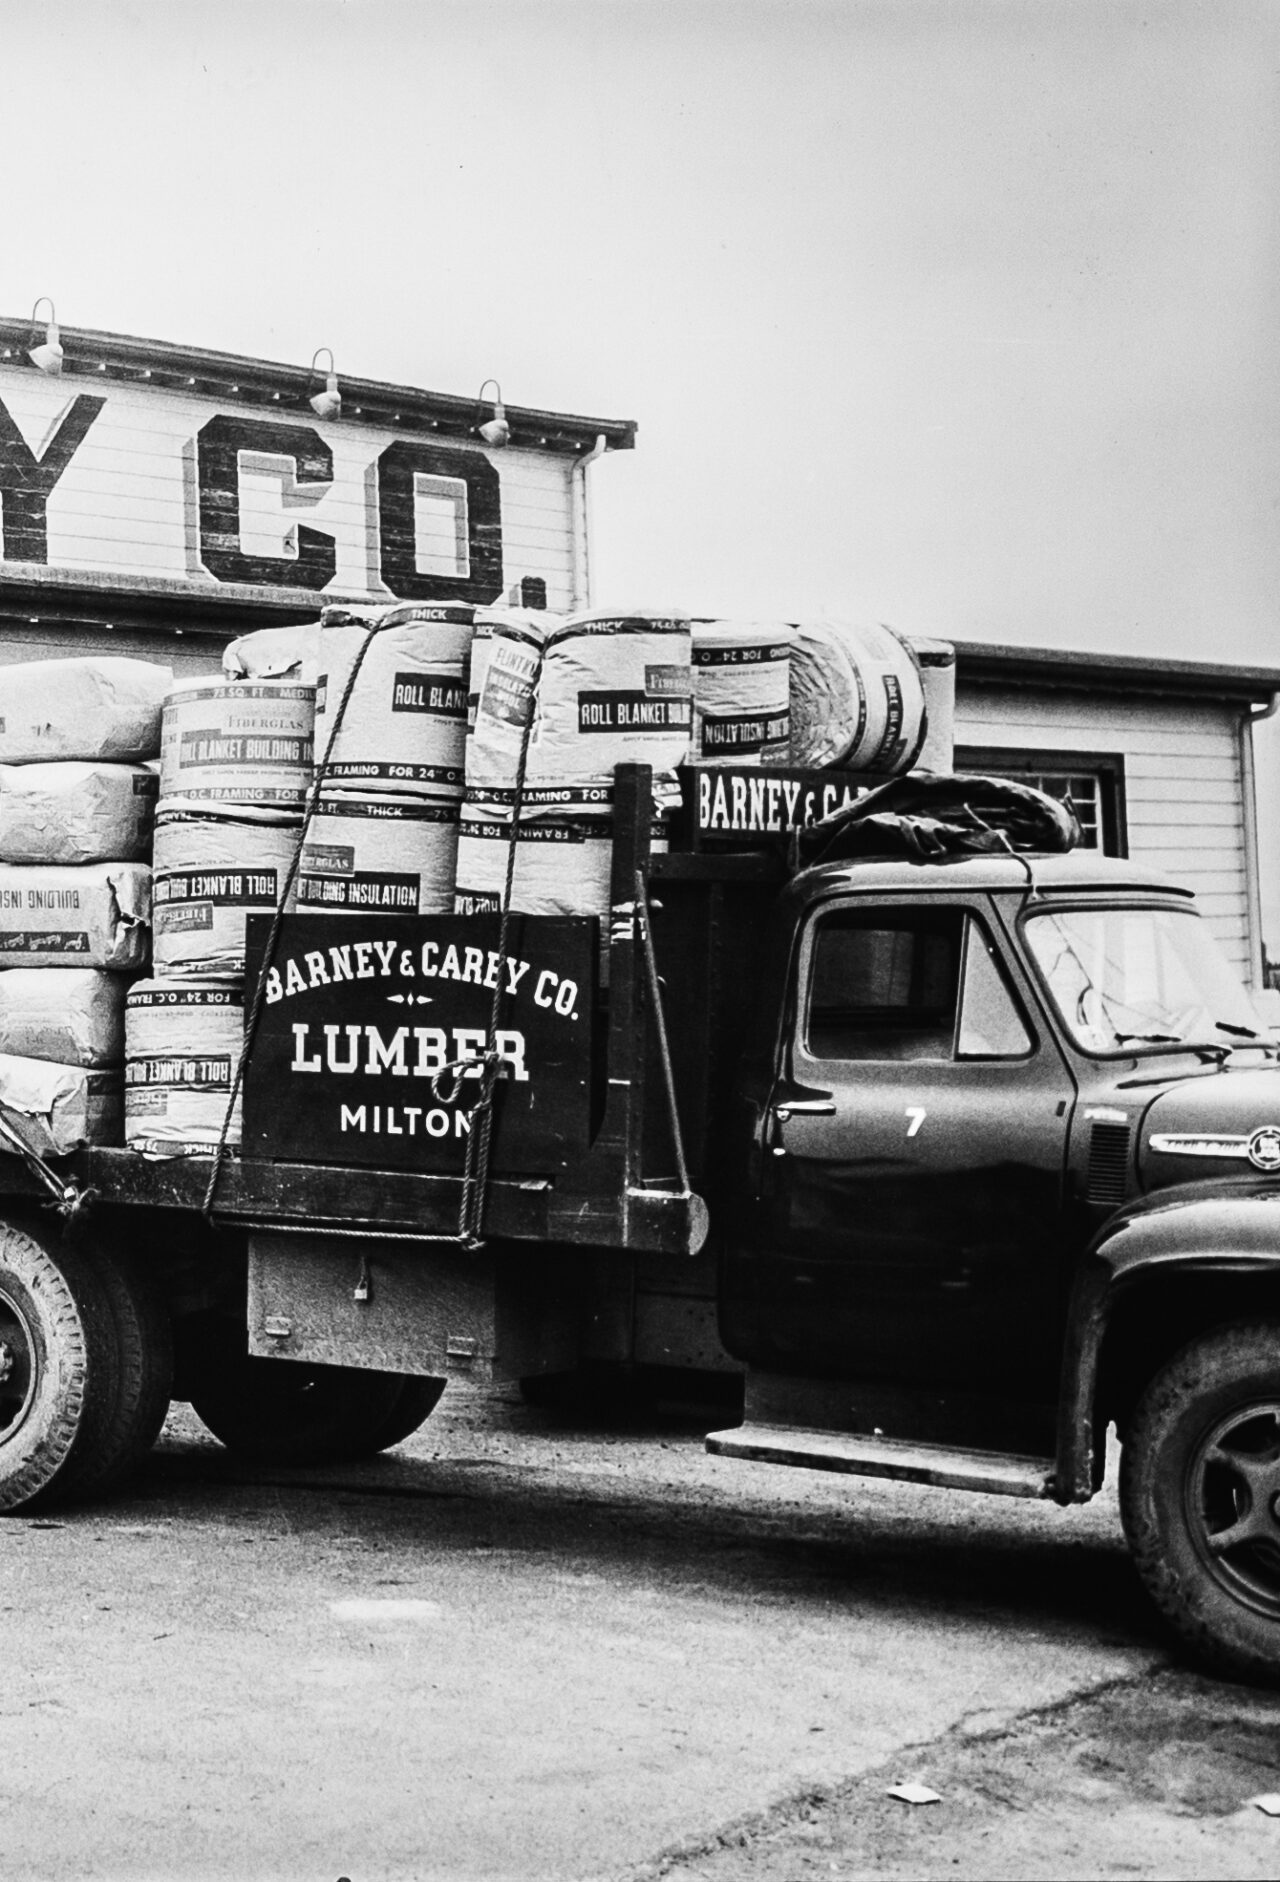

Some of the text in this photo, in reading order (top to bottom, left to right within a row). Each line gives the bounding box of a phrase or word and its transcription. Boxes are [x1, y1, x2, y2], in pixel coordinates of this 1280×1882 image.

[183, 414, 547, 609] CO.
[411, 609, 447, 620] THICK
[584, 620, 624, 633] THICK
[395, 684, 425, 706] ROLL
[228, 713, 304, 730] FIBERGLAS
[581, 703, 613, 725] ROLL
[617, 703, 666, 724] BLANKET
[705, 721, 765, 743] INSULATION
[246, 739, 300, 761] BUILDING
[333, 765, 380, 777] FRAMING
[389, 766, 414, 778] FOR
[210, 787, 265, 800] FRAMING
[275, 788, 300, 800] FOR
[582, 789, 608, 800] FOR
[699, 773, 872, 832] BARNEY & CA
[367, 805, 403, 817] THICK
[482, 825, 501, 837] FOR
[517, 828, 569, 840] FRAMIN
[190, 876, 242, 897] BLANKET
[246, 875, 275, 895] ROLL
[348, 883, 418, 907] INSULATION
[28, 889, 80, 909] BUILDING
[261, 941, 579, 1021] BARNEY & CAREY CO.
[154, 992, 178, 1004] O.C.
[206, 993, 231, 1004] FOR
[291, 1022, 530, 1082] LUMBER
[201, 1061, 229, 1082] ROLL
[340, 1104, 472, 1138] MILTON
[905, 1106, 927, 1136] 7
